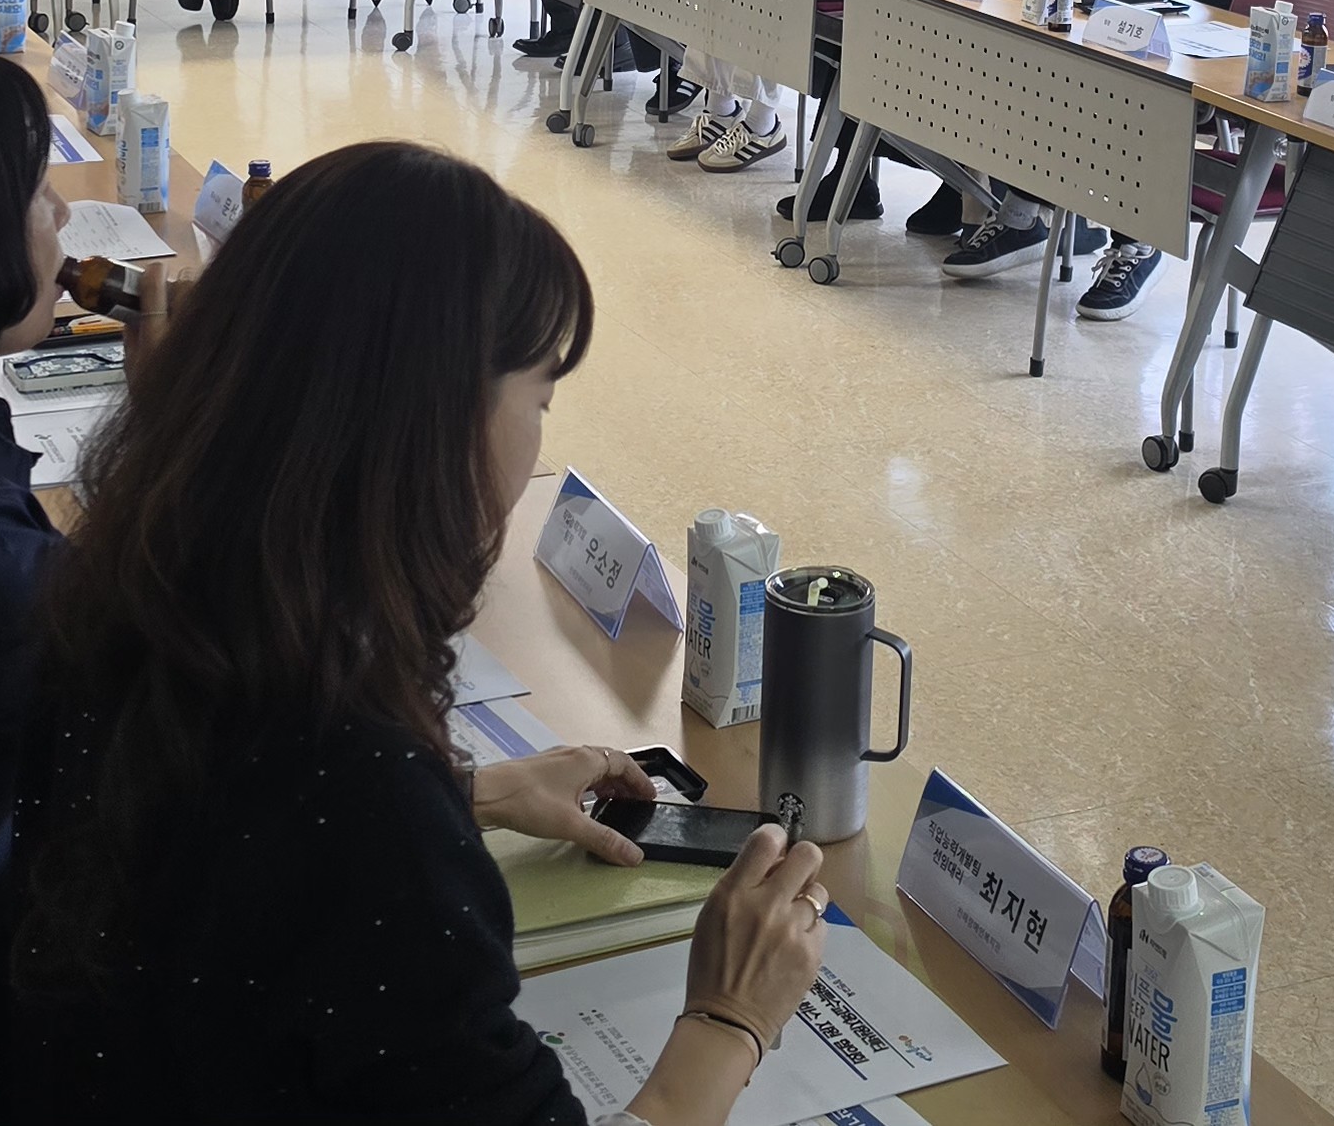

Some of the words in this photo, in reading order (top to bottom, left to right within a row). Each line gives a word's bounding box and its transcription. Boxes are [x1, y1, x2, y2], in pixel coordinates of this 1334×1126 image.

[585, 537, 623, 590] 우소정
[928, 819, 982, 877] 직업능력개발팀
[978, 871, 1048, 955] 최지현
[932, 847, 964, 886] 선임대리
[809, 978, 889, 1053] 원특수교육지원센터
[1131, 998, 1146, 1017] EEP
[1150, 987, 1178, 1043] 물
